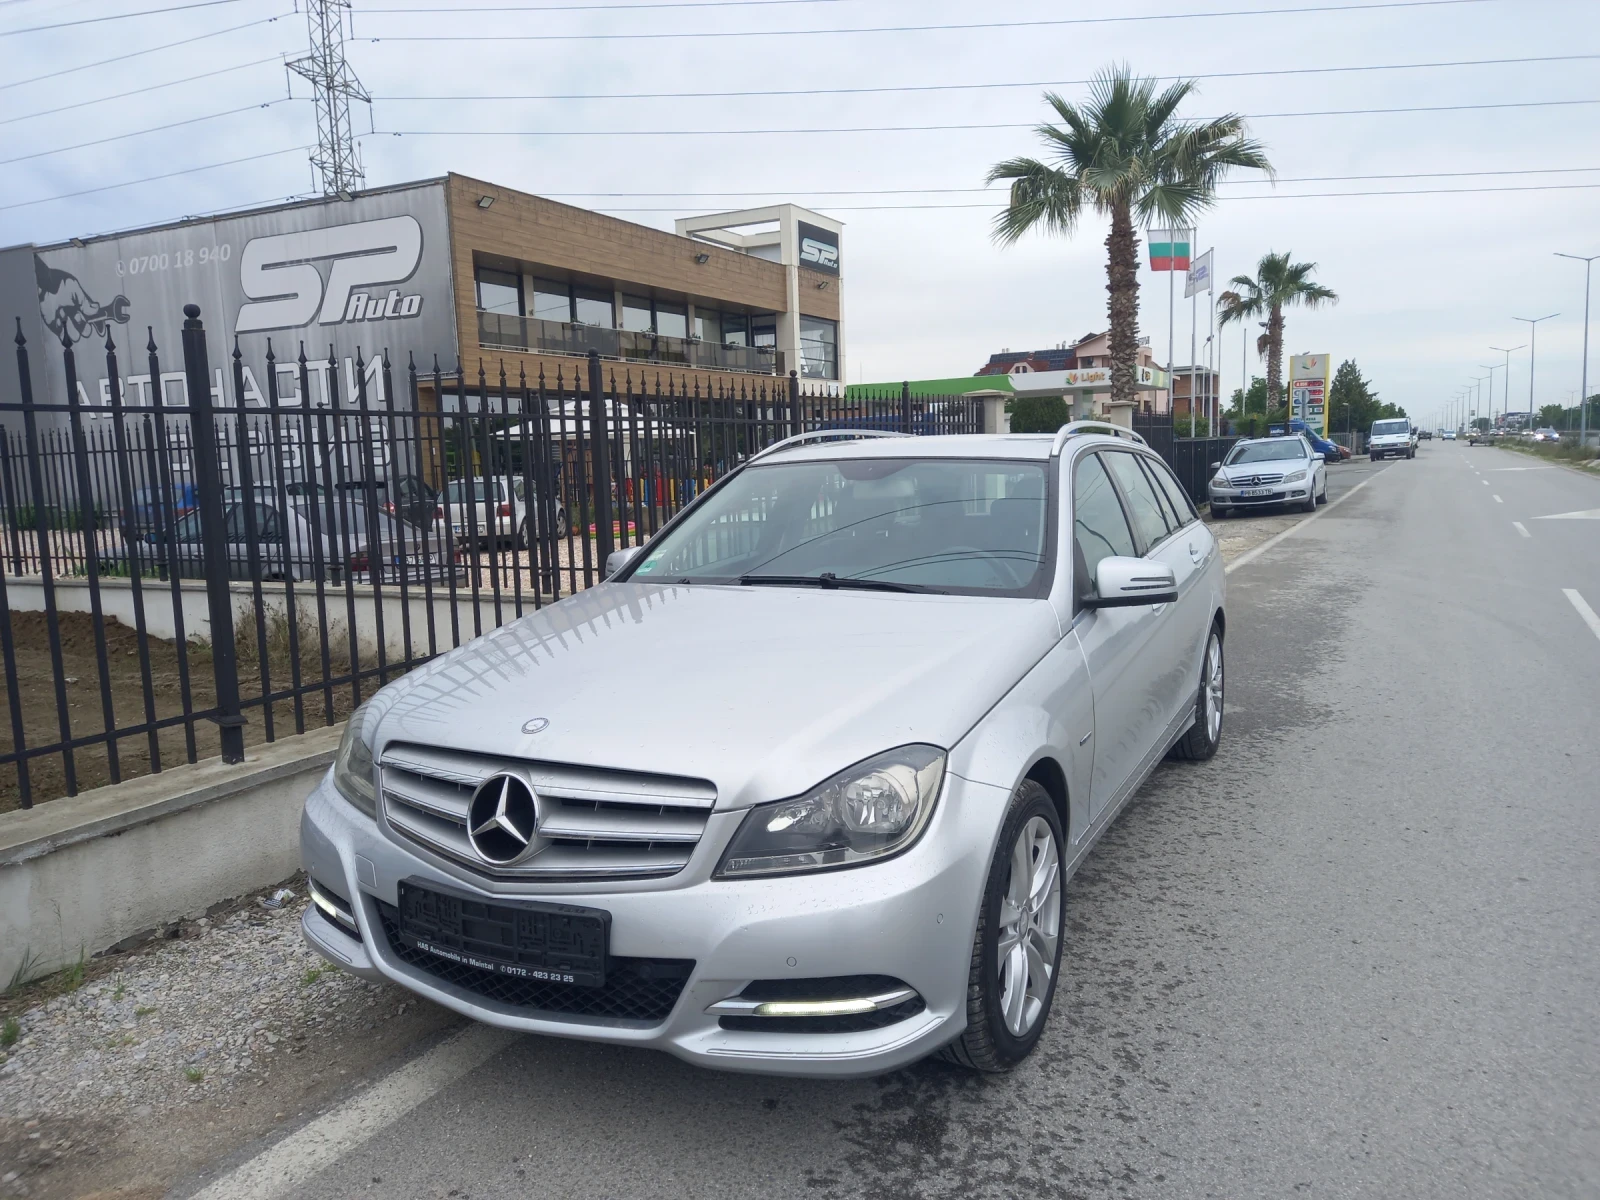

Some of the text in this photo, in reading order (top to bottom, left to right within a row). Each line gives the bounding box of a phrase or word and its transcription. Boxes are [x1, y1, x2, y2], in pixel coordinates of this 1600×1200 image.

[129, 243, 231, 276] 0700 18 940
[800, 237, 838, 264] SP
[234, 215, 424, 335] SP
[345, 290, 423, 322] Auto
[1081, 372, 1105, 382] Light
[429, 945, 461, 962] Automobile
[461, 955, 468, 964] in
[469, 958, 494, 971] Maintal
[507, 966, 527, 976] 0172
[533, 970, 549, 980] 423
[550, 972, 561, 982] 23
[563, 973, 574, 983] 25
